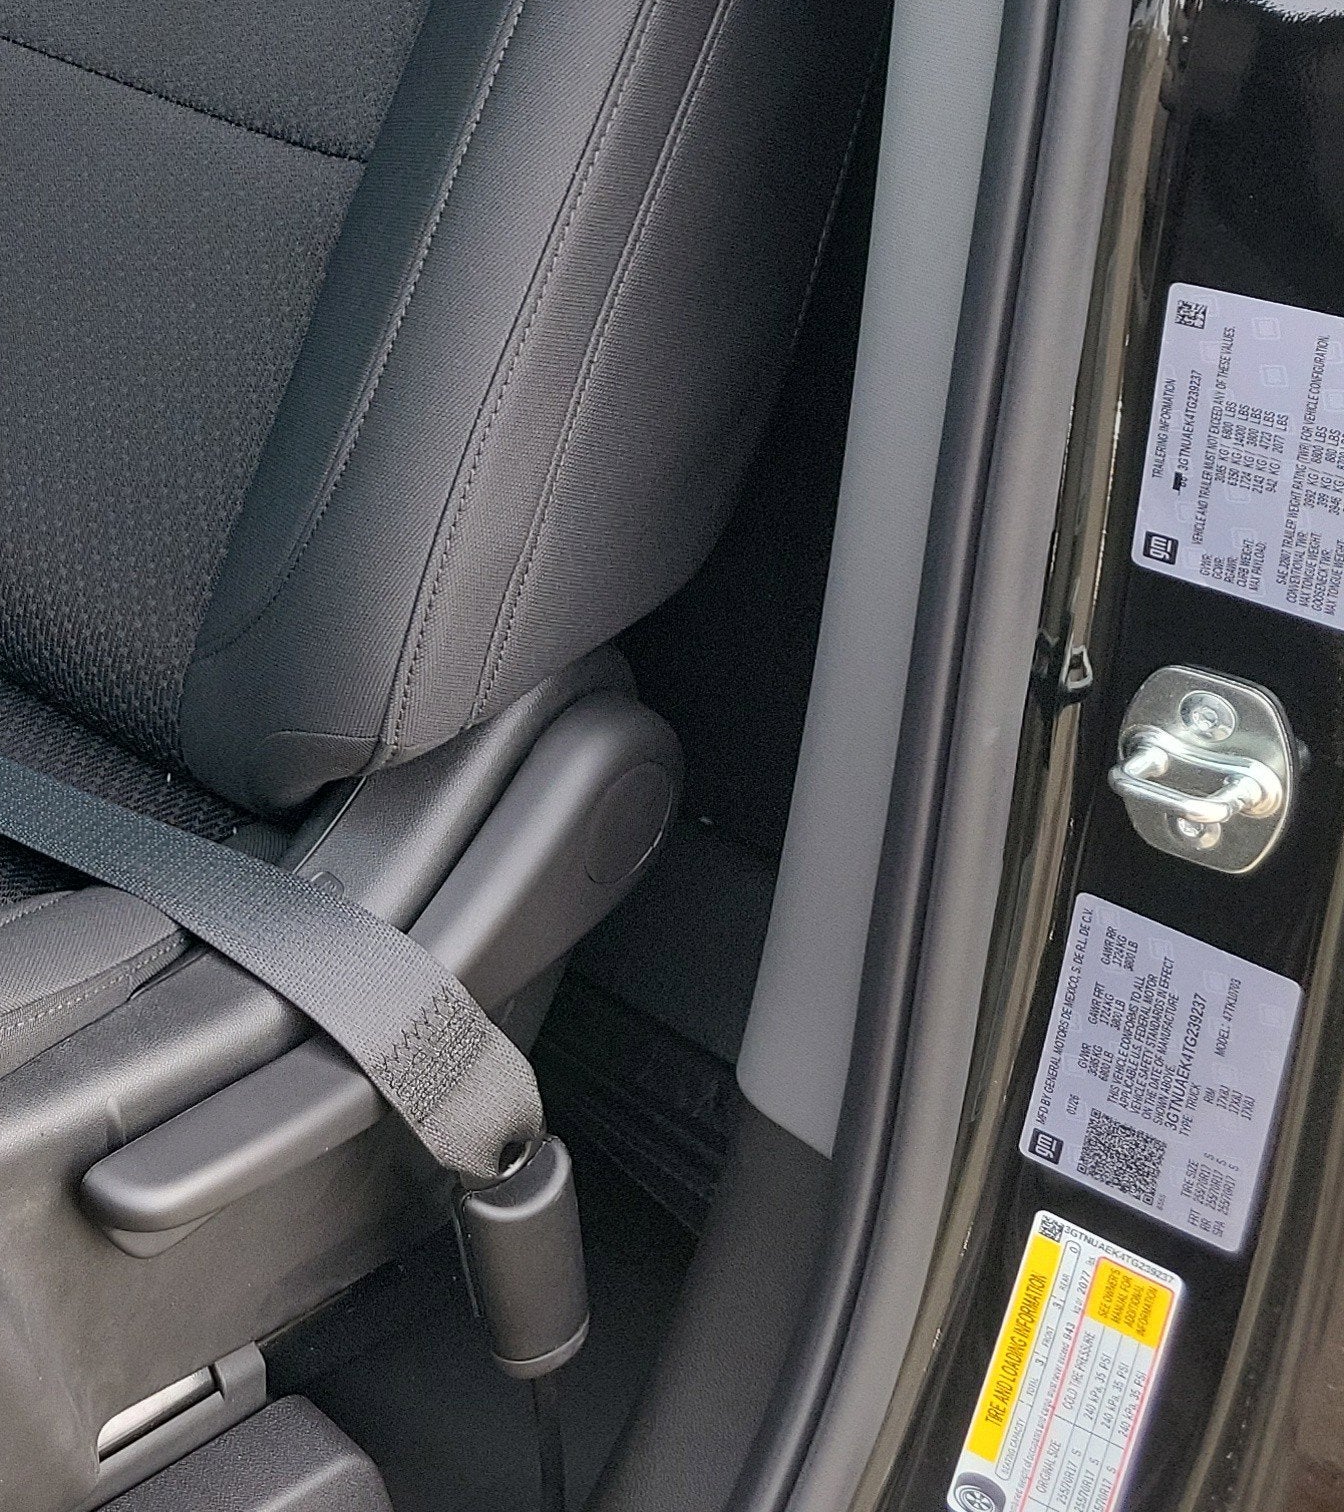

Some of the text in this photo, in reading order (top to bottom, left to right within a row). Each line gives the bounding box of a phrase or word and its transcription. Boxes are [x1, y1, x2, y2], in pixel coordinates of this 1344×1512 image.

[1224, 400, 1237, 418] LBS
[1237, 403, 1250, 421] LBS
[1249, 406, 1262, 424] LBS
[1303, 394, 1319, 425] VEHICLE
[1151, 377, 1175, 479] TRAILERING INFORMATION
[1191, 324, 1236, 546] VEHICLE AND TRAILER MUST NOT EXCEED ANY OF THESE VALUES.
[1221, 420, 1234, 440] 6800
[1300, 425, 1313, 441] FOR
[1327, 428, 1341, 447] LBS
[1251, 474, 1264, 493] 2143
[1262, 409, 1275, 428] LBS
[1248, 412, 1288, 592] MAX 942 2077 LBS
[1285, 425, 1327, 604] CONVENTIONAL LBS
[1286, 490, 1302, 519] WEIGHT
[1281, 518, 1297, 549] TRAILER
[1275, 569, 1288, 585] SAE
[1301, 560, 1317, 591] TONGUE
[1298, 591, 1311, 608] MAX
[1078, 923, 1090, 936] DE
[1099, 925, 1117, 965] GAWR RR
[1072, 951, 1084, 964] DE
[1059, 1006, 1071, 1020] DE
[1086, 981, 1106, 1025] GAWR FRT
[1051, 1018, 1068, 1055] MOTORS
[1106, 973, 1145, 1104] THIS VEHICLE CONFORMS TO ALL
[1118, 973, 1158, 1109] APPLICABLE U.S. FEDERAL MOTOR
[1129, 956, 1173, 1114] VEHICLE SAFETY STANDARDS IN EFFECT
[1214, 1023, 1231, 1057] MODEL:
[1076, 1041, 1091, 1069] GVWR
[1140, 992, 1178, 1120] ON THE DATE OF MANUFACTURE
[1163, 992, 1207, 1131] 3GTNUAEK4TG239237
[1042, 1054, 1060, 1094] GENERAL
[1040, 1092, 1051, 1106] BY
[1065, 1092, 1079, 1115] 01/26
[1152, 1093, 1168, 1125] SHOWN
[1184, 1081, 1201, 1111] TRUCK
[1035, 1104, 1049, 1125] MFD
[1180, 1158, 1199, 1198] TIRE SIZE
[1012, 1270, 1047, 1339] INFORMATION
[1063, 1270, 1091, 1340] 943 2077
[1097, 1301, 1110, 1318] SEE
[1110, 1274, 1132, 1324] MANUAL FOR
[1123, 1283, 1144, 1327] ADDITIONAL
[1135, 1285, 1157, 1336] INFORMATION
[1040, 1325, 1053, 1347] FRONT
[1073, 1329, 1094, 1371] PRESSURE
[998, 1334, 1027, 1383] LOADING
[991, 1379, 1013, 1405] AND
[1068, 1369, 1082, 1387] TIRE
[1083, 1352, 1111, 1420] 240 35 PSI
[1132, 1369, 1146, 1387] PSI
[1100, 1411, 1114, 1429] 240
[1115, 1361, 1129, 1378] PSI
[1128, 1388, 1140, 1400] 35
[984, 1400, 1007, 1428] TIRE
[1047, 1439, 1061, 1458] SIZE
[1088, 1456, 1099, 1465] S
[1056, 1447, 1081, 1505] 255/70R17 S
[1106, 1464, 1116, 1473] S
